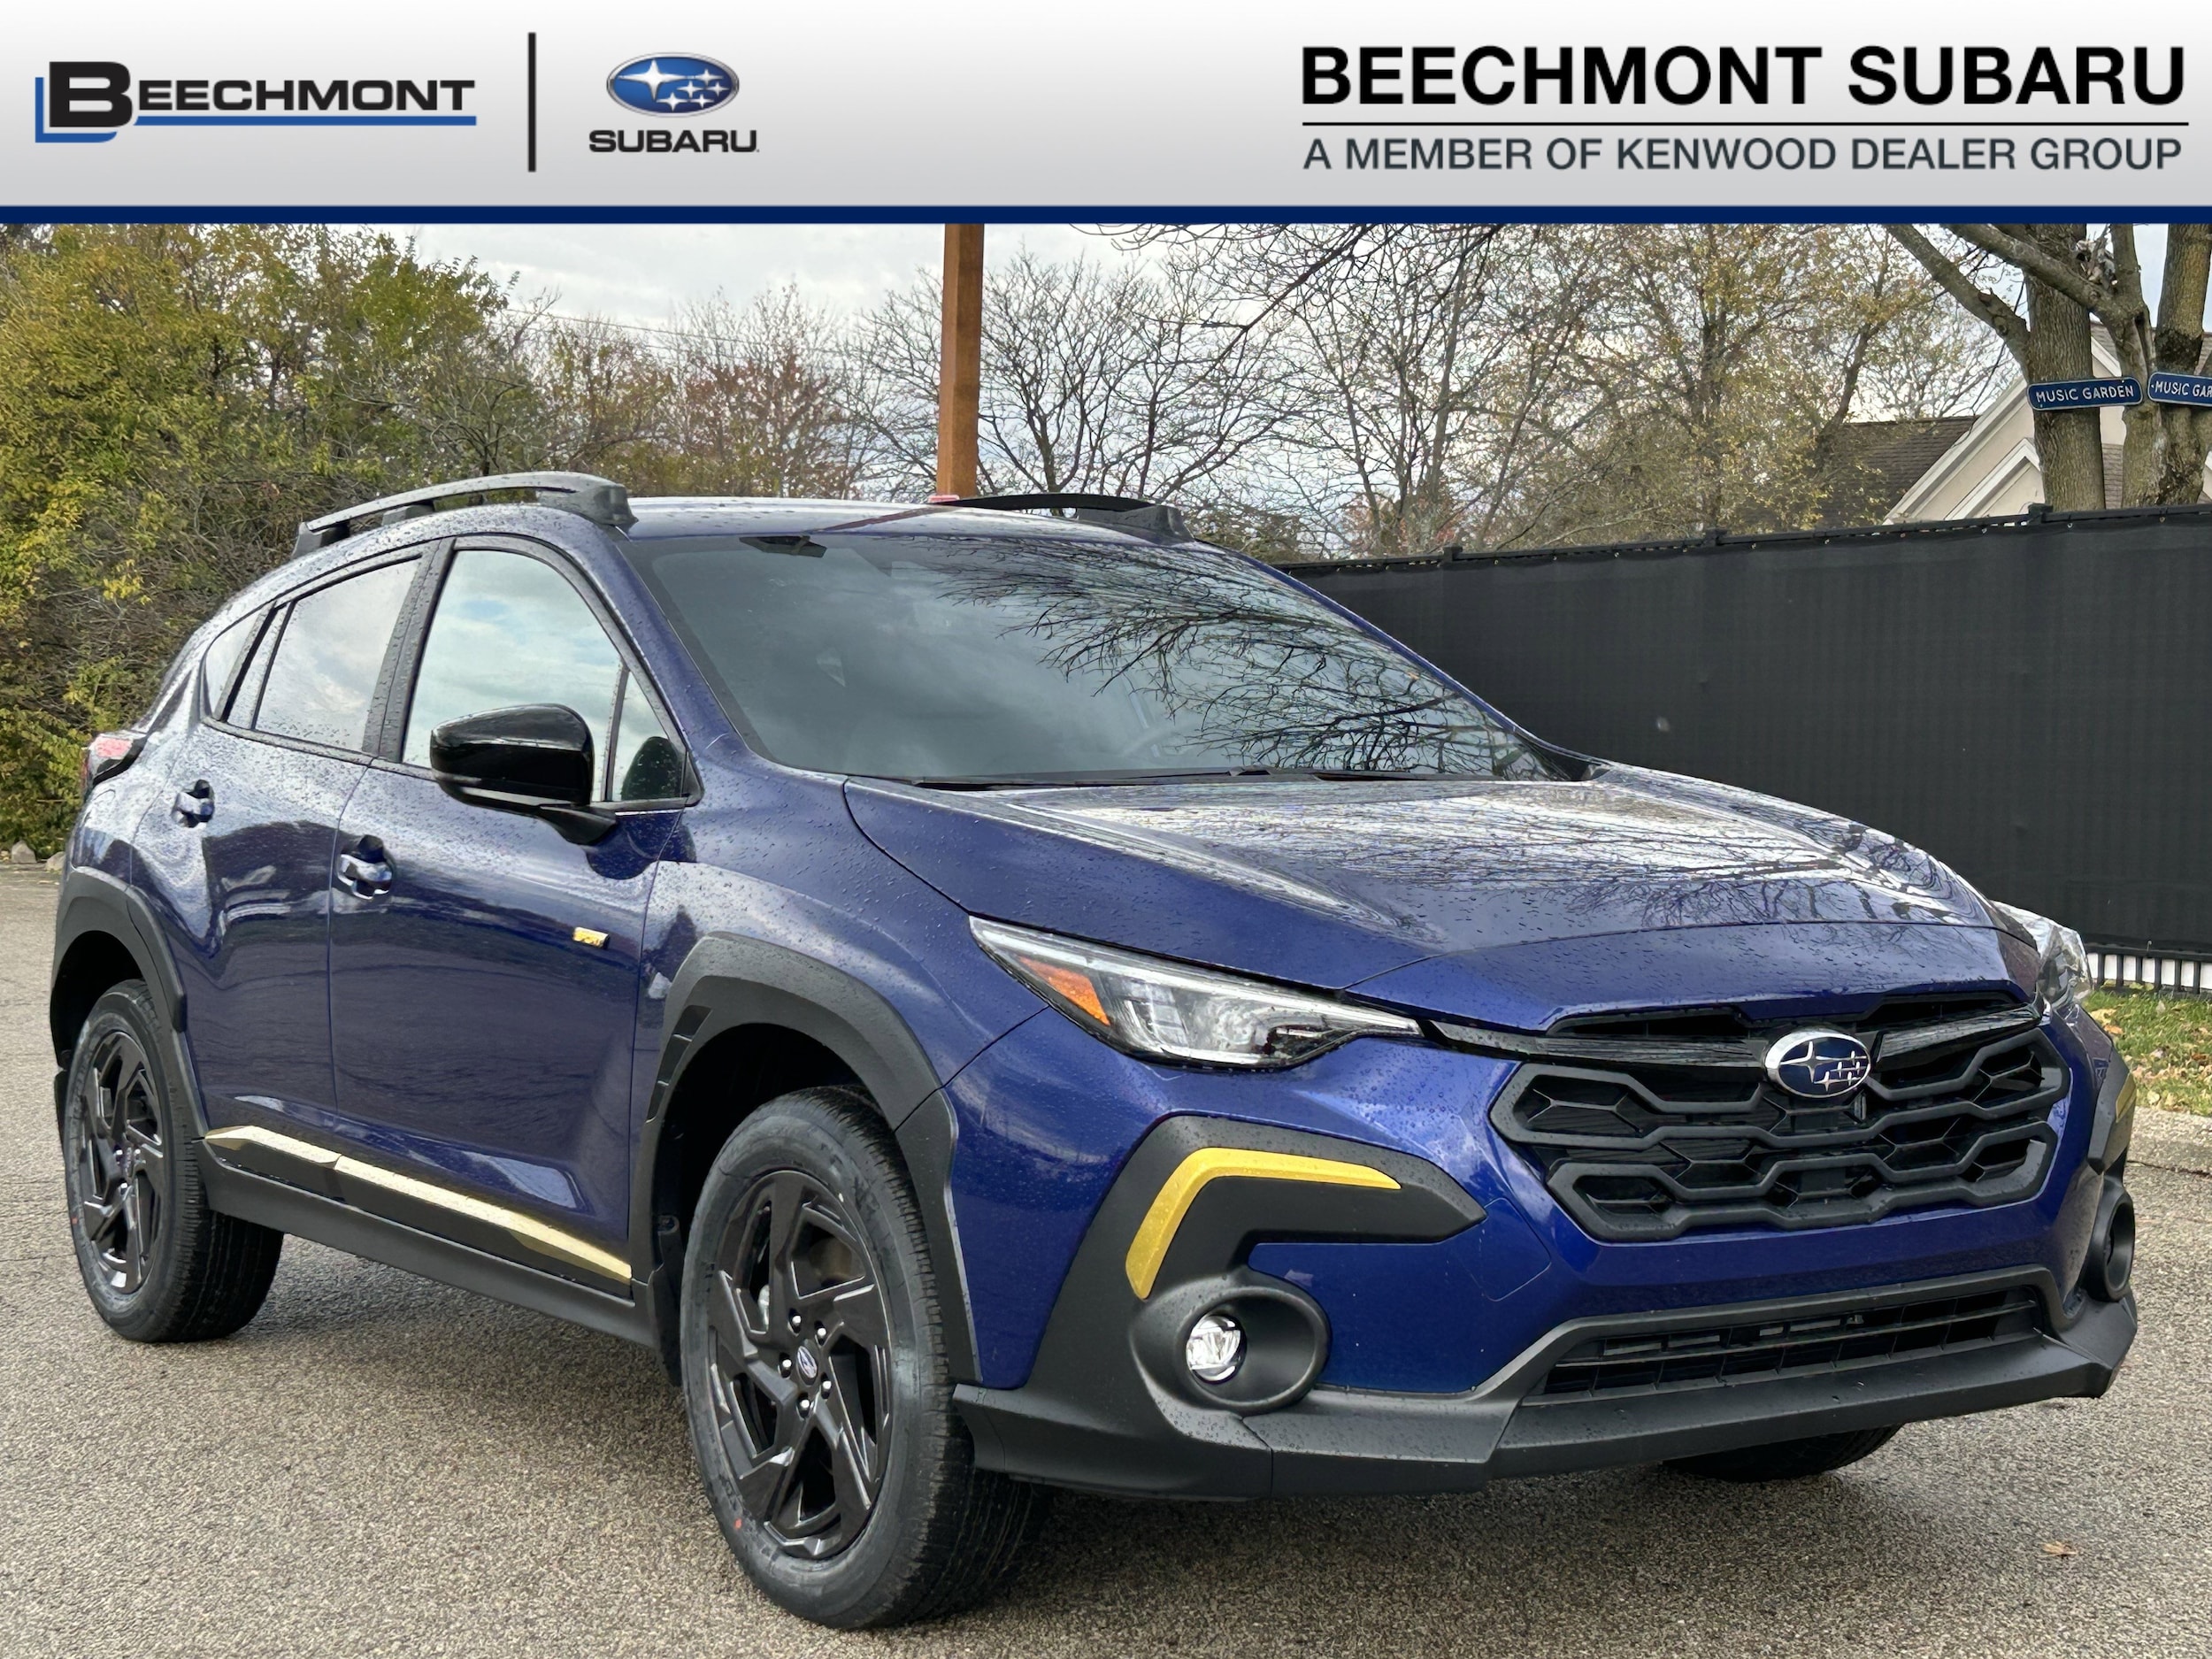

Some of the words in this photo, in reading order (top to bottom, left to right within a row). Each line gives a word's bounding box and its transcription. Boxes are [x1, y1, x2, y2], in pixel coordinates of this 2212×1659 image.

[2035, 388, 2078, 403] MUSIC
[2082, 385, 2134, 400] GARDEN
[2154, 380, 2190, 396] MUSIC
